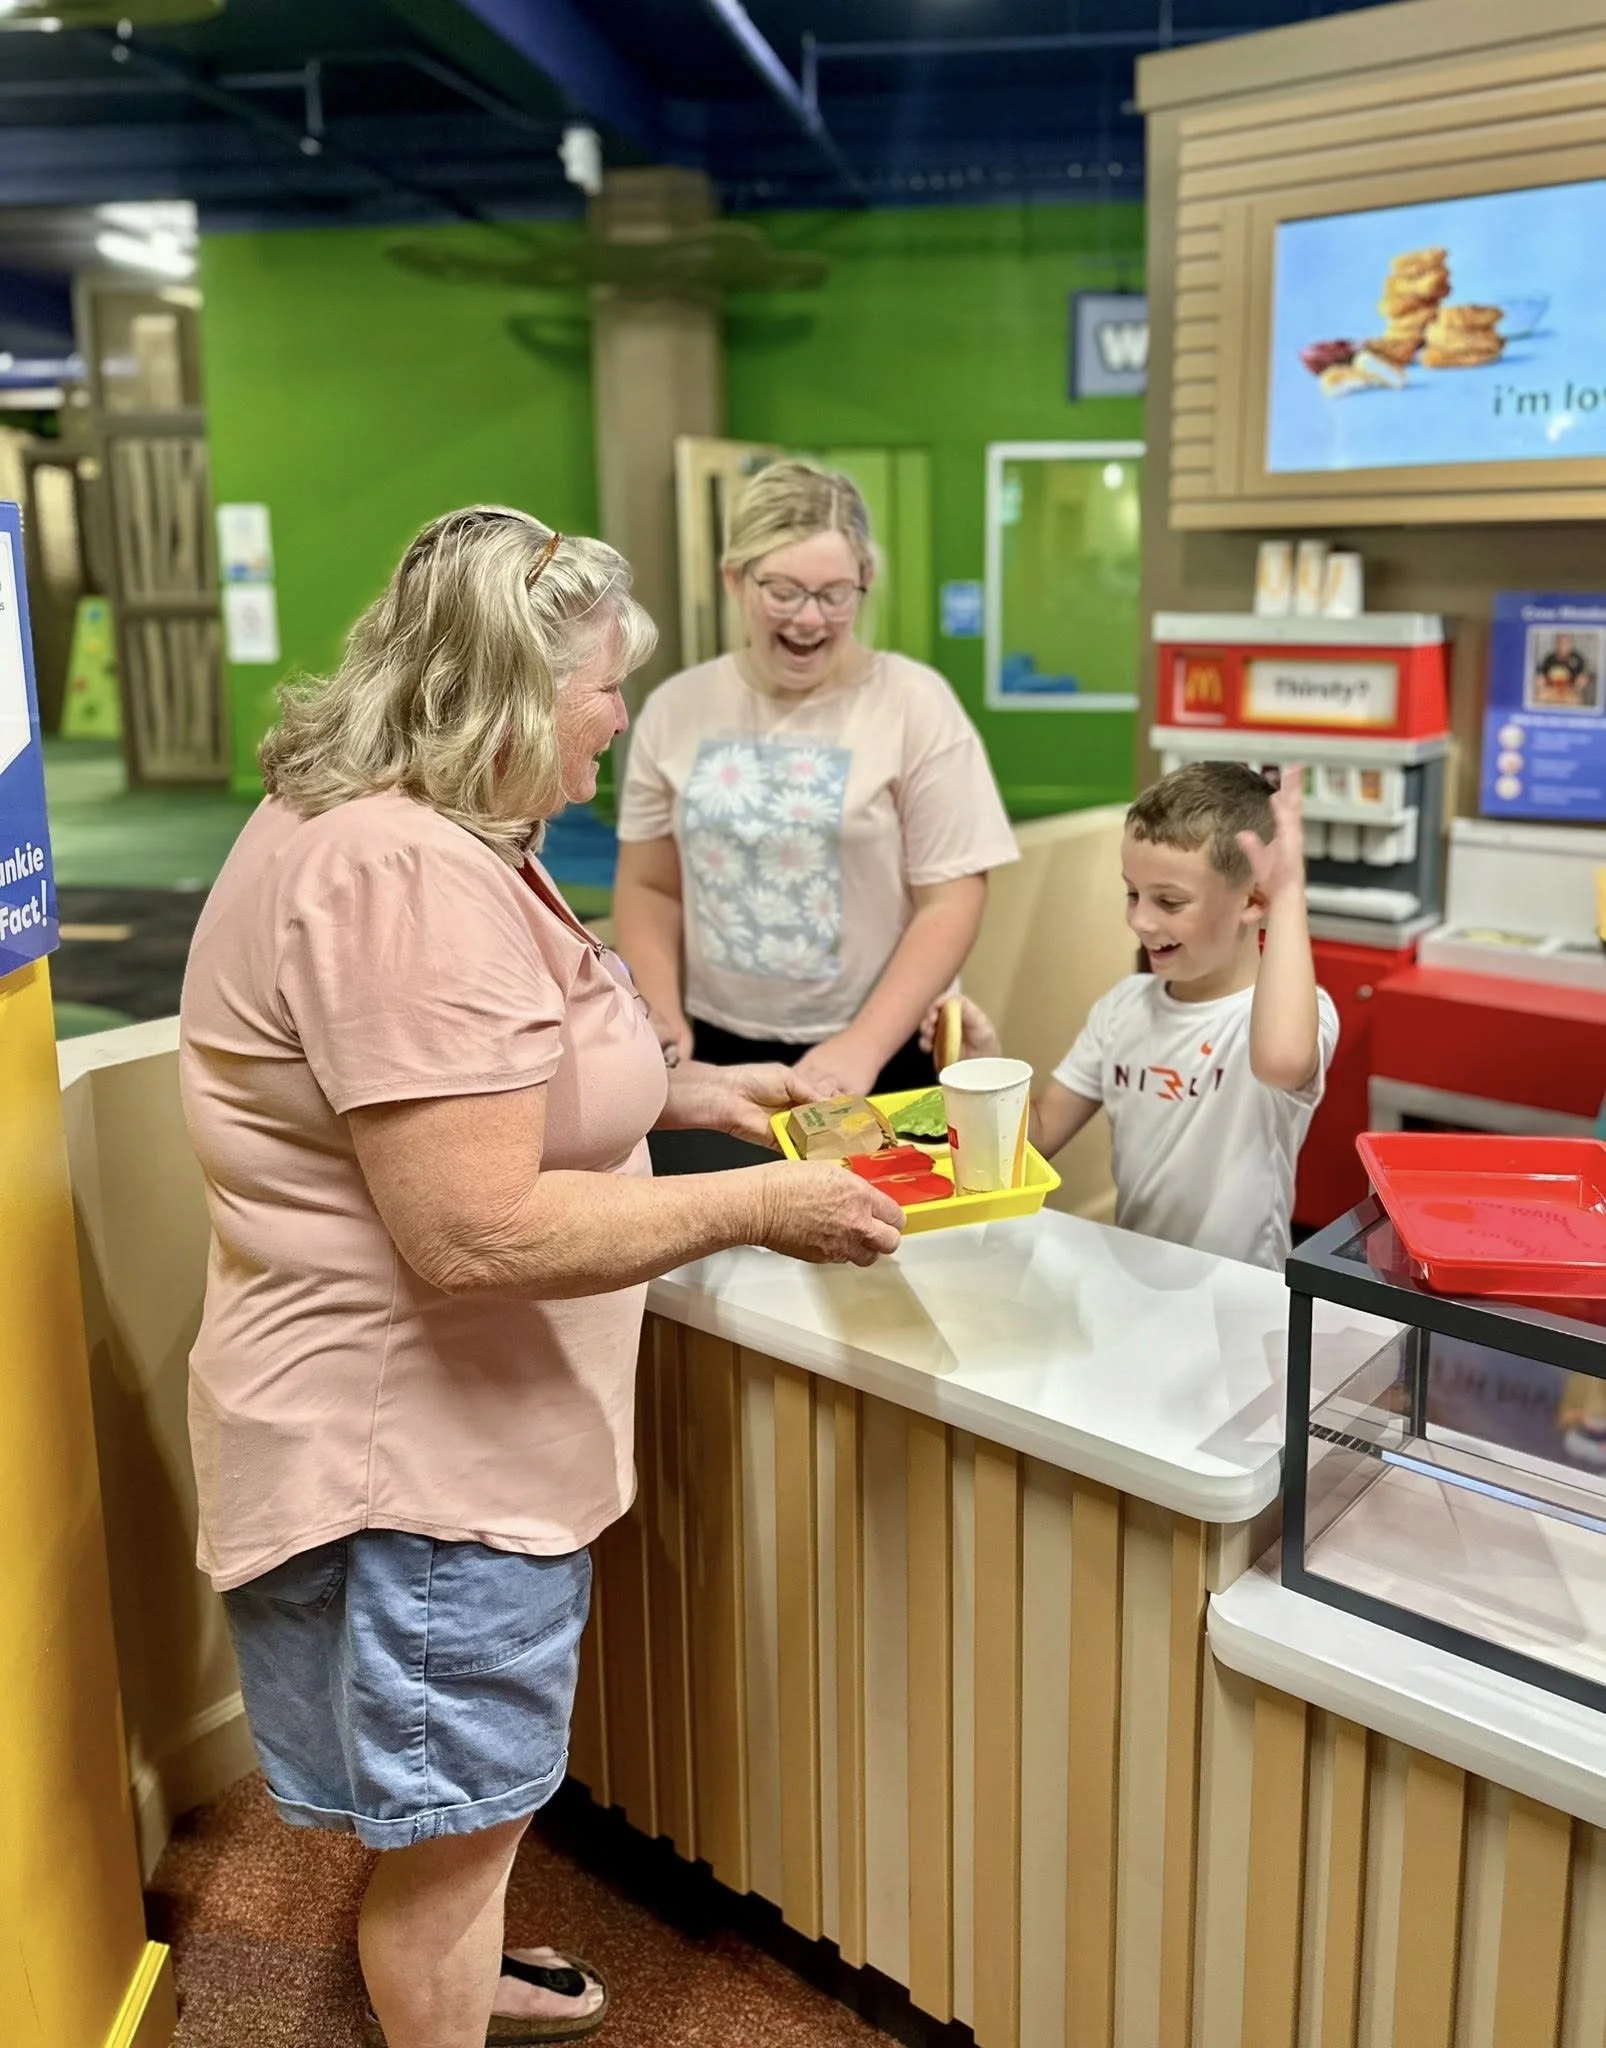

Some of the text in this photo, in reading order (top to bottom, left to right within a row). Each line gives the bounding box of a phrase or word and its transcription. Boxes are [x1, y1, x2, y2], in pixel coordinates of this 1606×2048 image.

[1494, 381, 1606, 416] i'm lo
[1273, 676, 1371, 704] Thirsty?
[0, 879, 47, 941] Fact!
